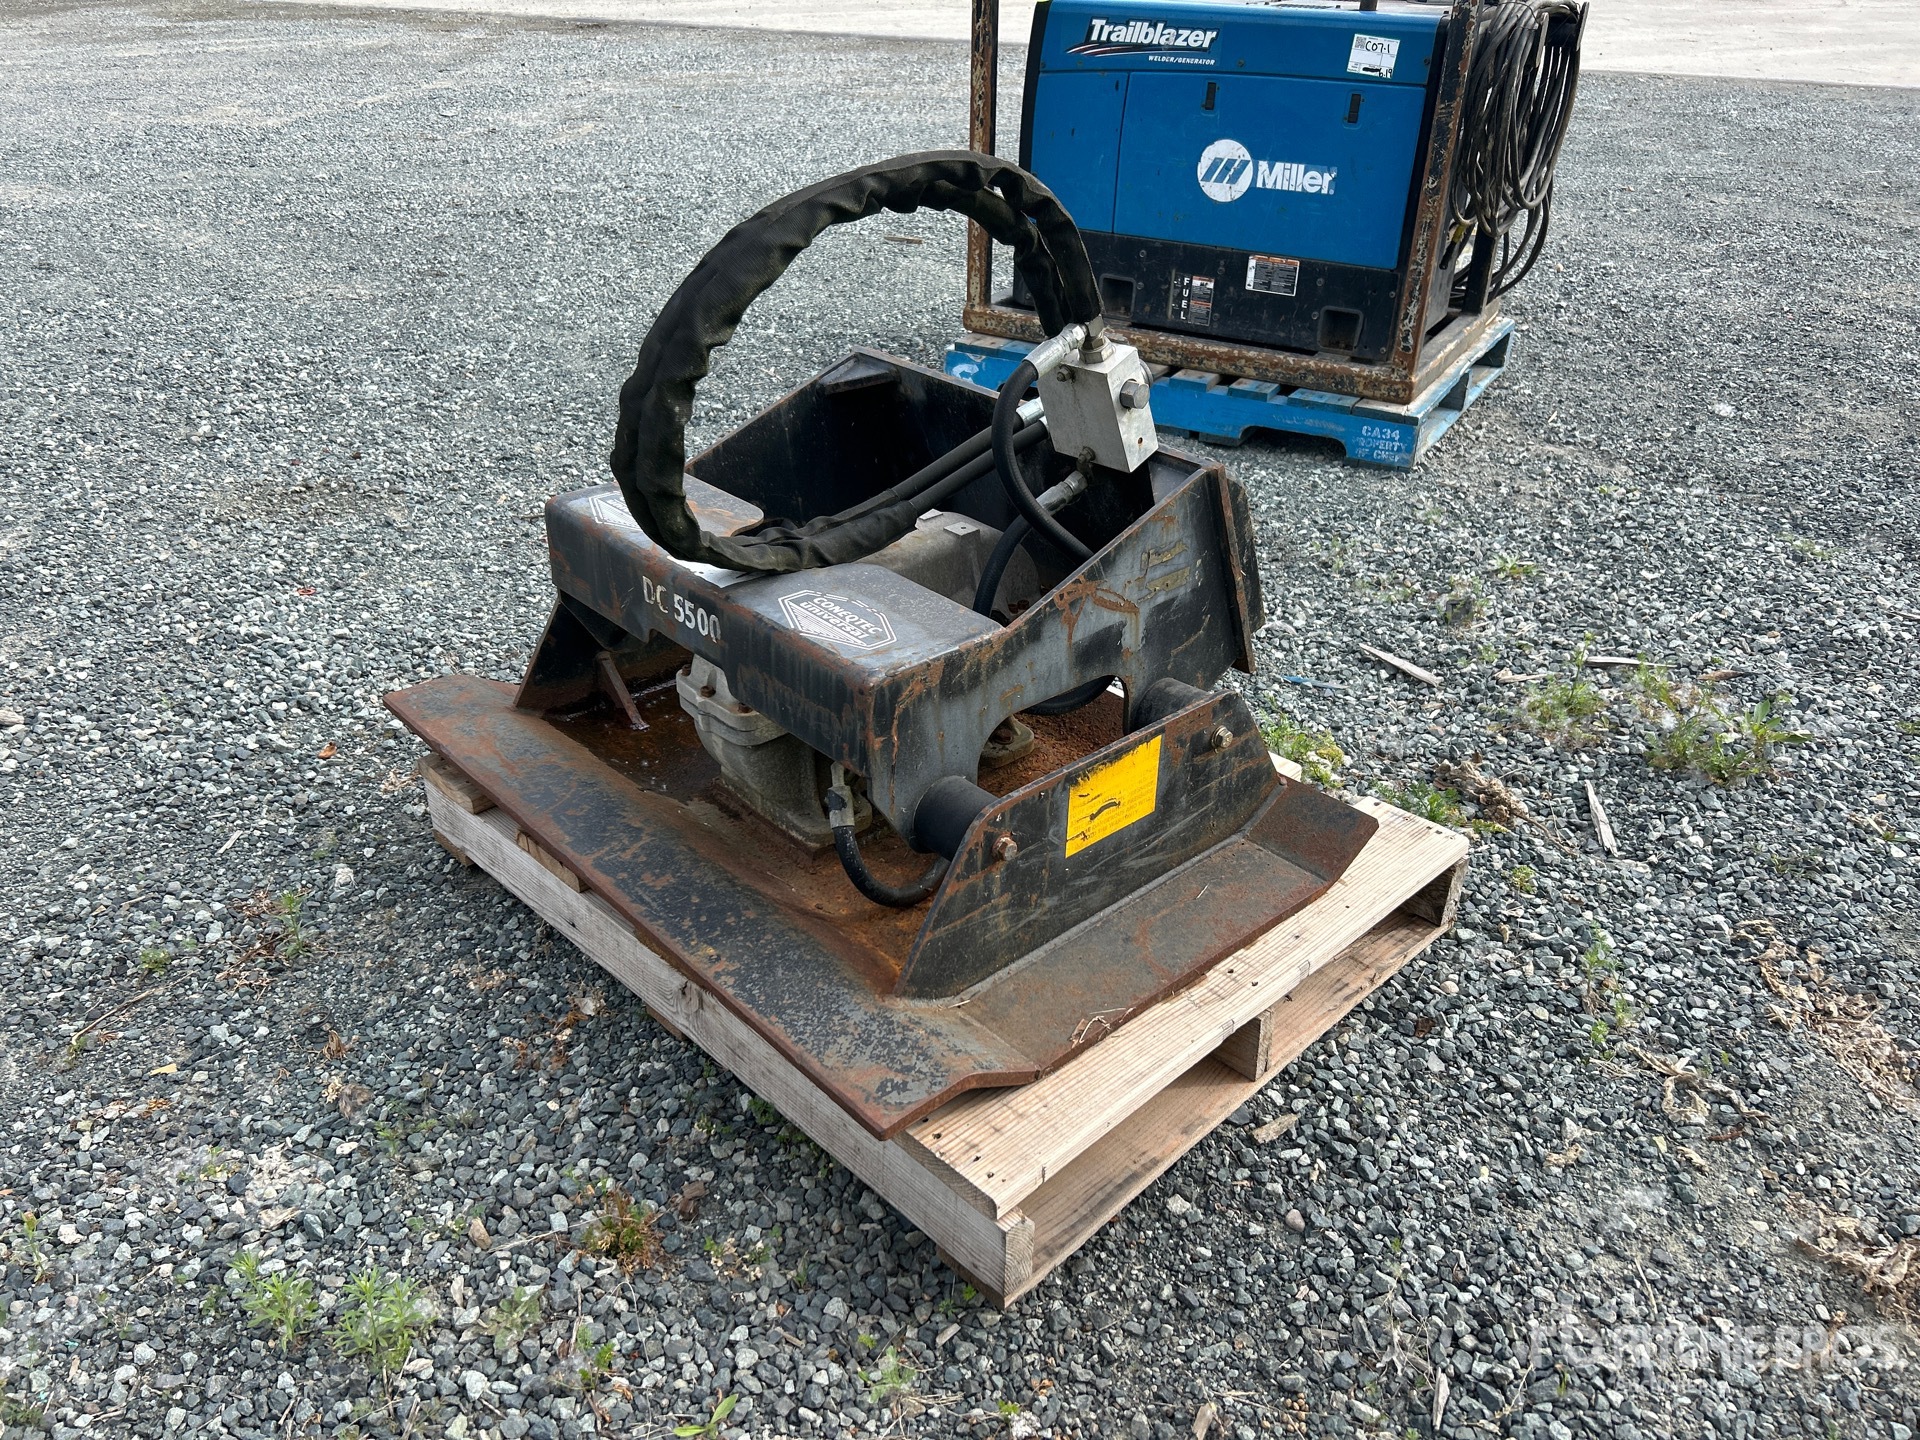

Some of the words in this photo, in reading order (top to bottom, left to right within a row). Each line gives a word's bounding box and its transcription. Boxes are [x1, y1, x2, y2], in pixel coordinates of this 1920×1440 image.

[1091, 18, 1217, 48] Trailblazer
[1148, 55, 1216, 66] WELDER/GENERATOR
[1256, 160, 1337, 195] Miller
[1180, 277, 1190, 320] FUEL
[1361, 425, 1400, 441] CA34
[642, 575, 669, 614] DC
[673, 593, 721, 644] 5500
[800, 601, 870, 639] universal
